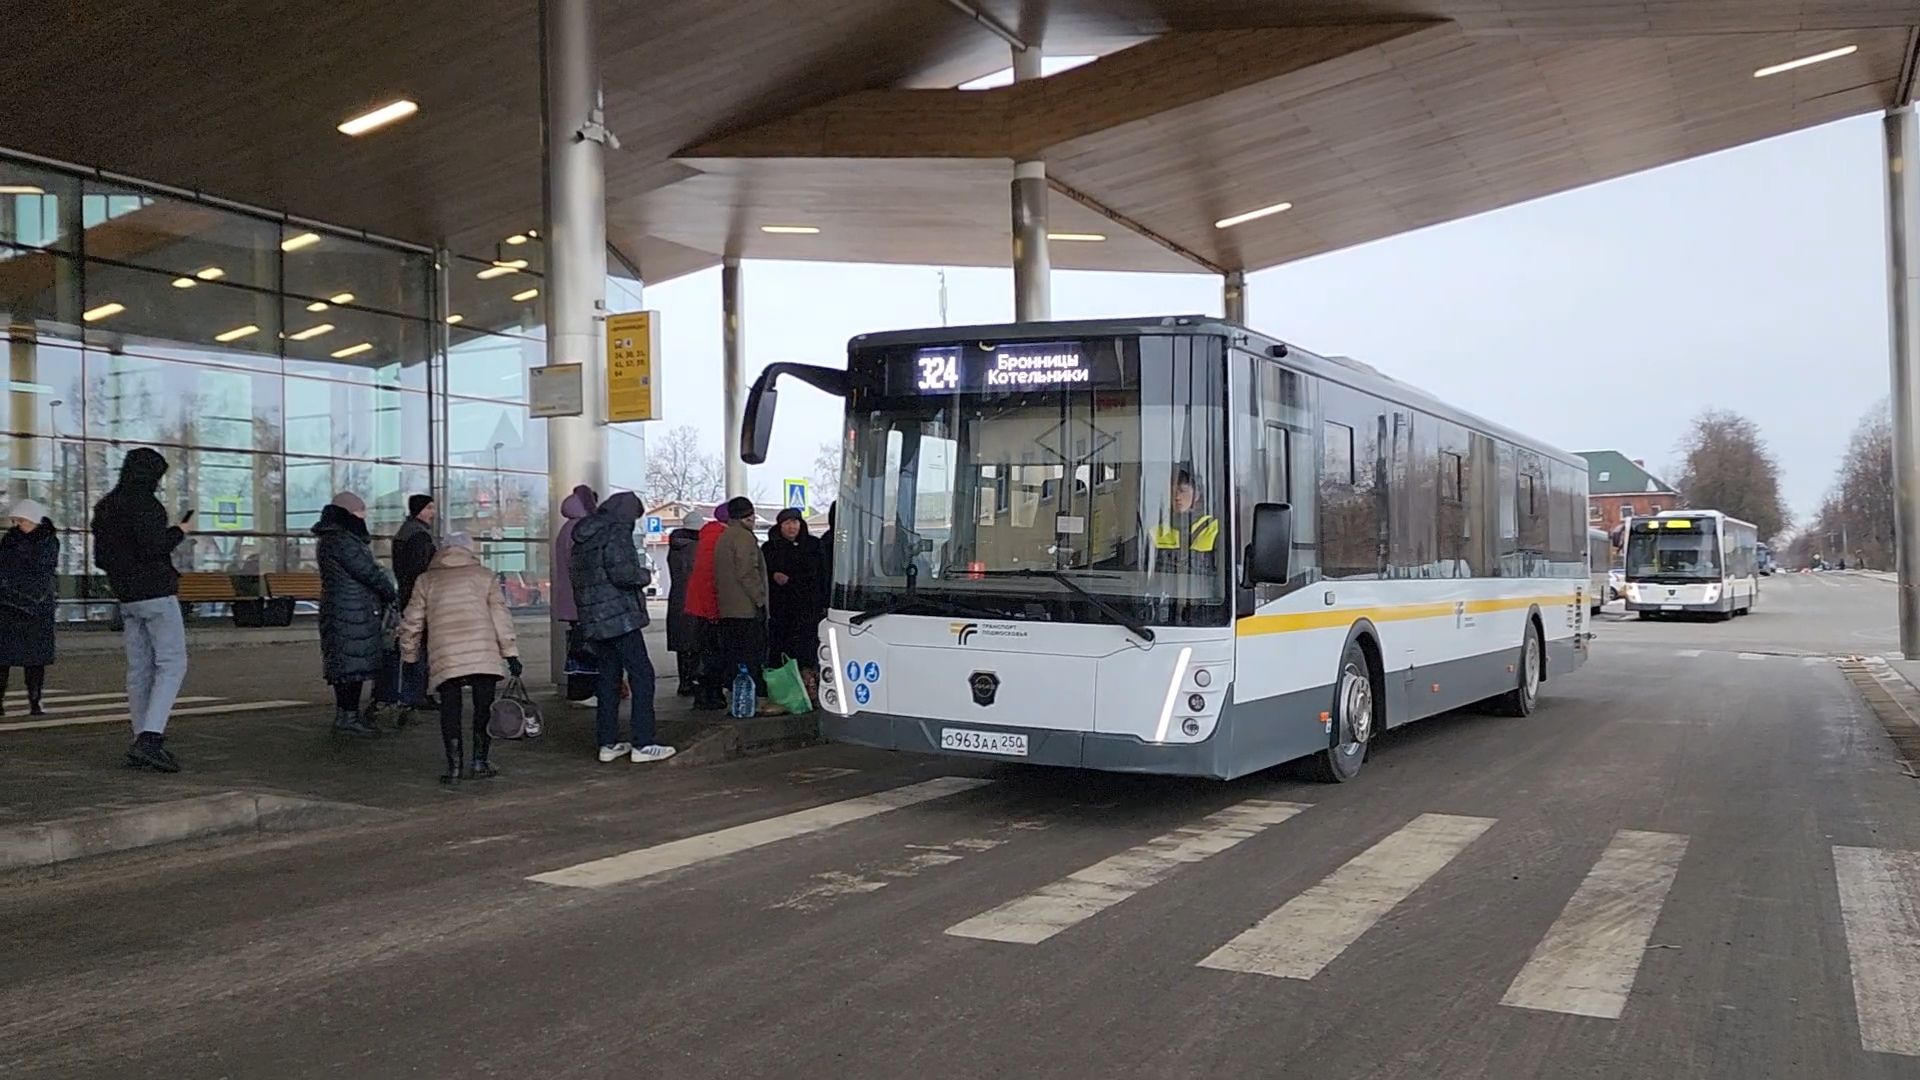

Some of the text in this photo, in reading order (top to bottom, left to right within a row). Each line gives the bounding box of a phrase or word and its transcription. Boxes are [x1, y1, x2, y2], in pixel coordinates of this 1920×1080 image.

[998, 354, 1079, 369] Бронницы
[918, 356, 958, 389] 324
[988, 369, 1089, 385] Котельники
[650, 519, 658, 531] P
[1002, 736, 1023, 748] 250
